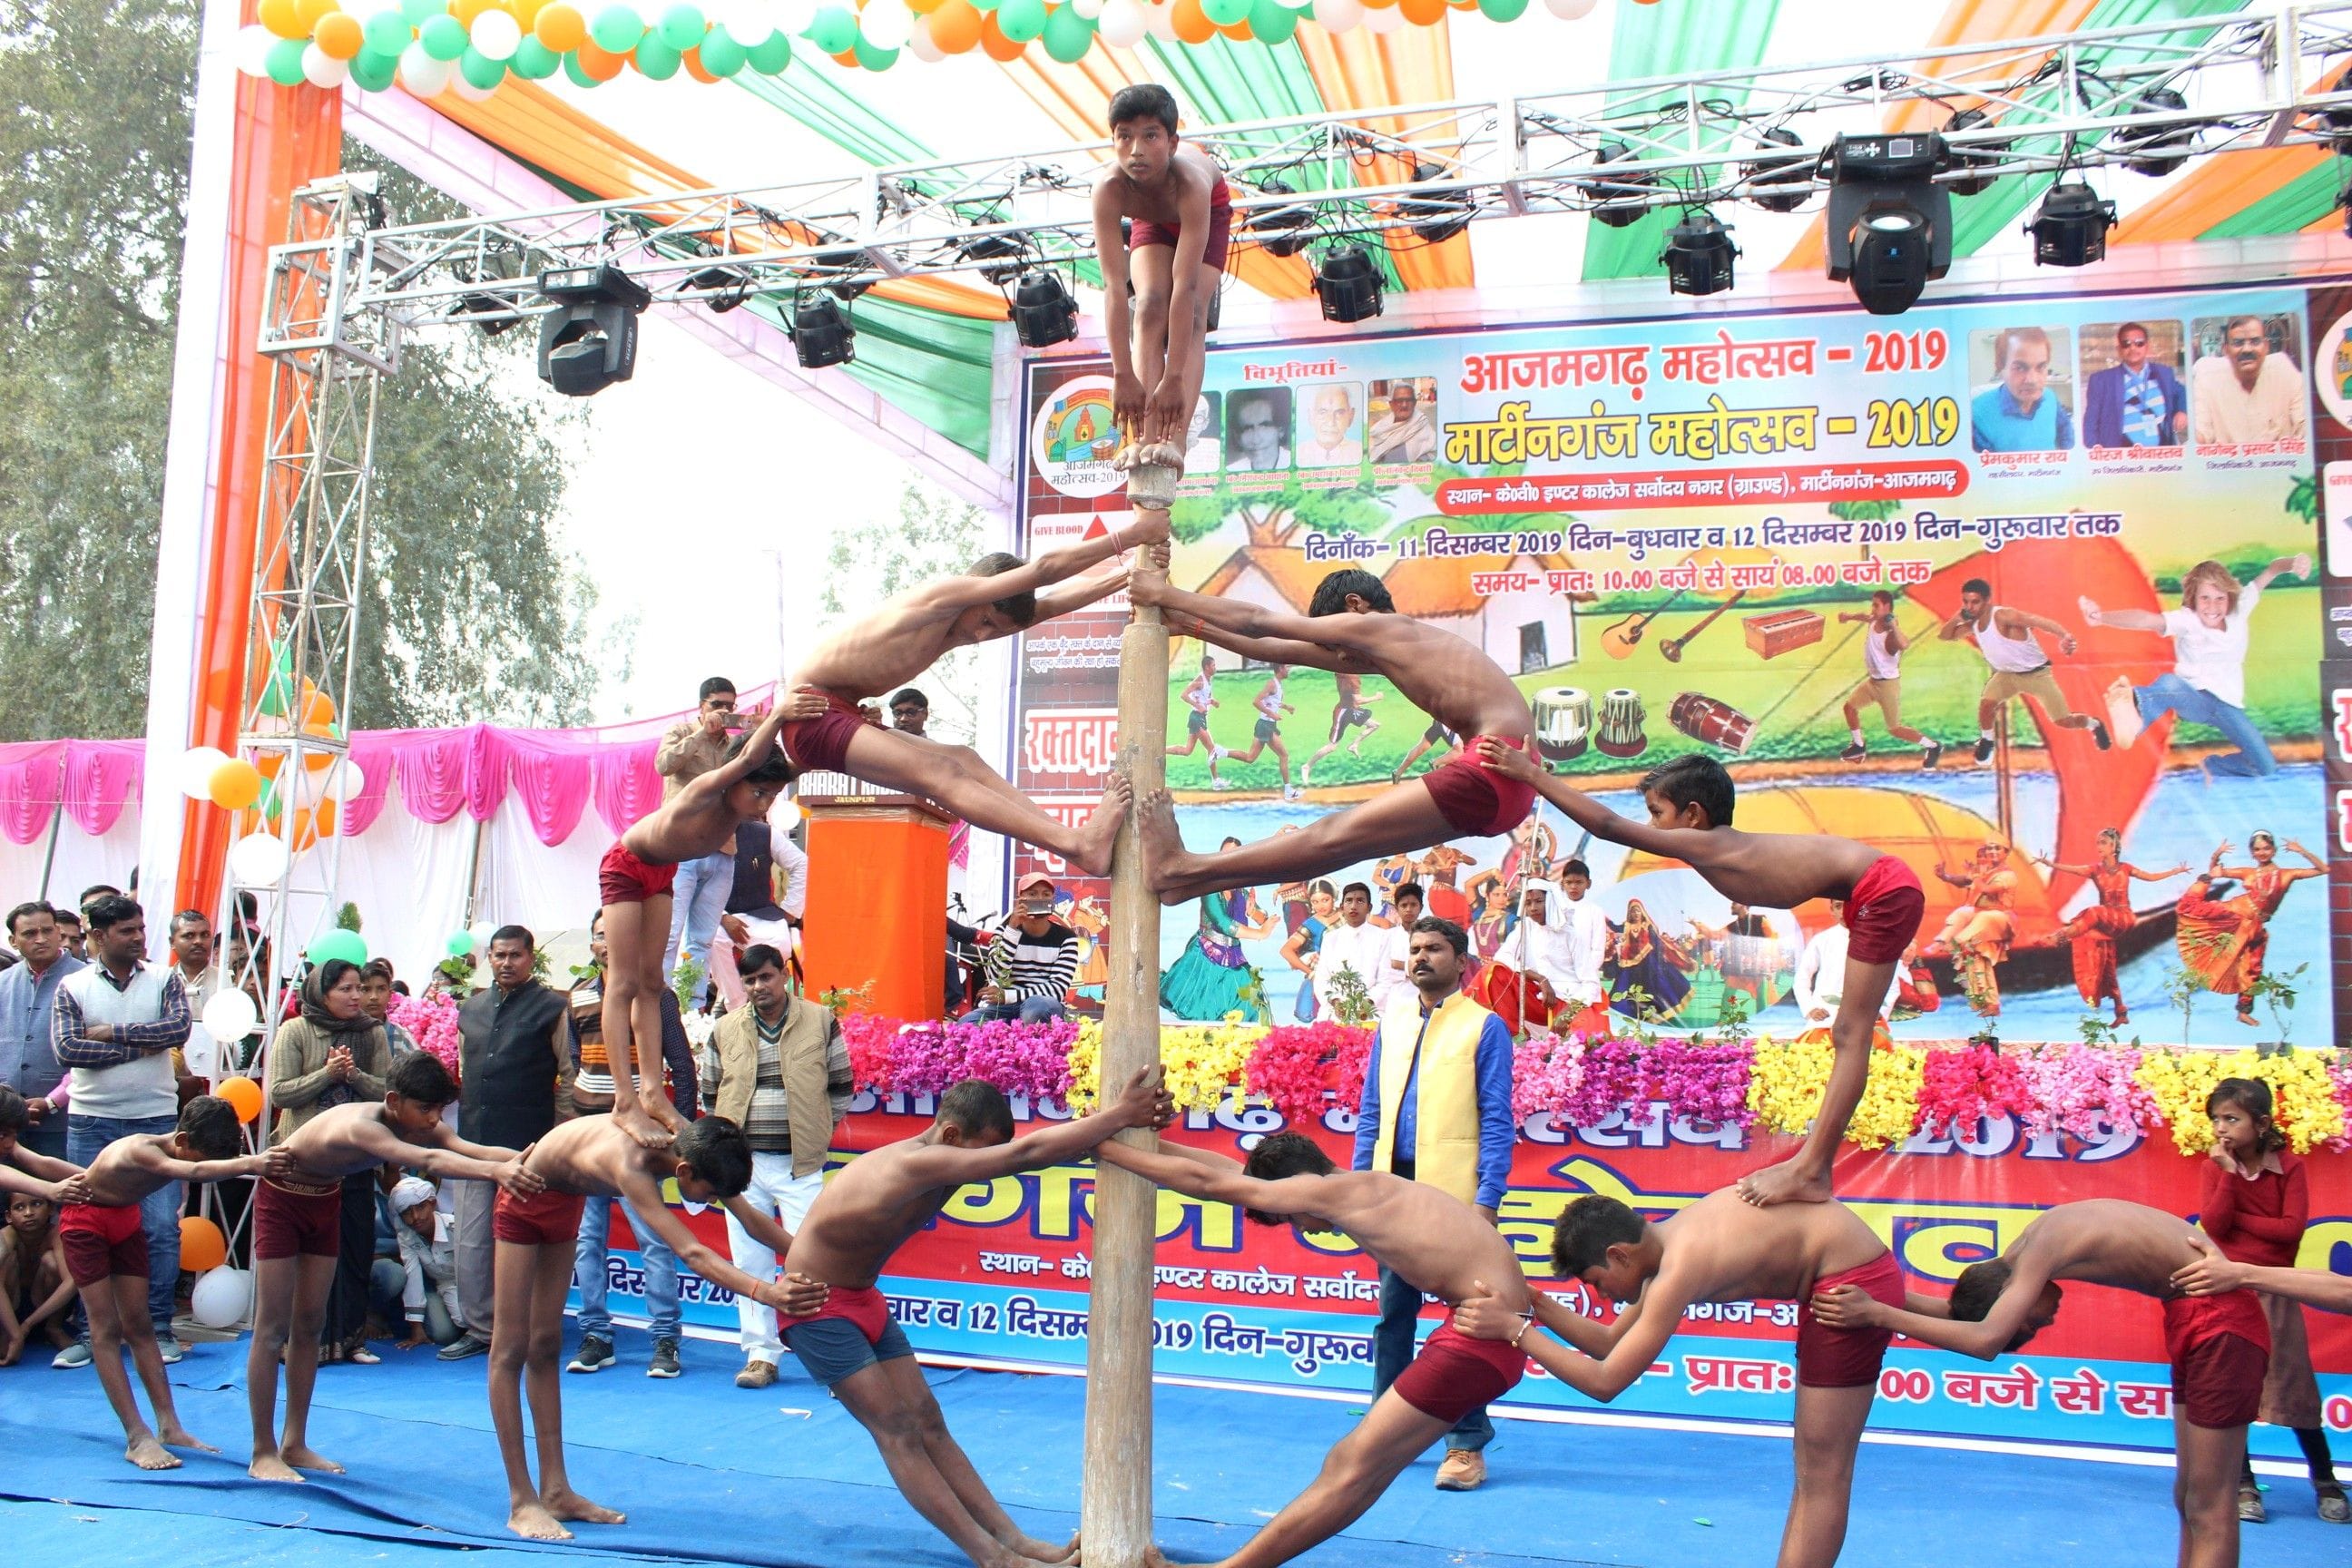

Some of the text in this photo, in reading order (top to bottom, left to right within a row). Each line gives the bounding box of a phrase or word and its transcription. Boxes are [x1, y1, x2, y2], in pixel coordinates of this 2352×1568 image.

[1462, 347, 1650, 400] आजमगढ़
[1661, 330, 1816, 384] महोत्सव
[1866, 330, 1946, 372] 2019
[1445, 399, 1641, 465] मार्टीनगंज
[1649, 393, 1818, 460] महोत्सव
[1867, 397, 1959, 448] 2019
[1446, 488, 1491, 505] स्थान-
[1544, 485, 1580, 504] इण्टर
[1582, 478, 1630, 500] कालेज
[1634, 475, 1686, 497] सर्वोदय
[1688, 480, 1723, 495] नगर
[1034, 524, 1083, 535] GIVE BLOOD
[1399, 538, 1417, 556] 11
[1426, 528, 1513, 556] दिसम्बर
[1516, 533, 1562, 553] 2019
[1707, 524, 1723, 546] व
[1733, 524, 1755, 546] 12
[1762, 516, 1854, 545] दिसम्बर
[1859, 522, 1906, 543] 2019
[2075, 513, 2122, 535] तक
[1473, 573, 1540, 593] समय-
[1603, 570, 1652, 590] 10.00
[1704, 560, 1724, 588] से
[1730, 557, 1779, 587] सायं
[1782, 564, 1834, 586] 08.00
[1888, 561, 1931, 583] तक
[978, 1251, 1054, 1277] स्थान-
[1210, 1266, 1296, 1296] कालेज
[1303, 1269, 1380, 1301] सर्वोद
[937, 1301, 960, 1328] व
[971, 1305, 997, 1331] 12
[1945, 1366, 2040, 1407] बजे
[2053, 1369, 2105, 1411] से
